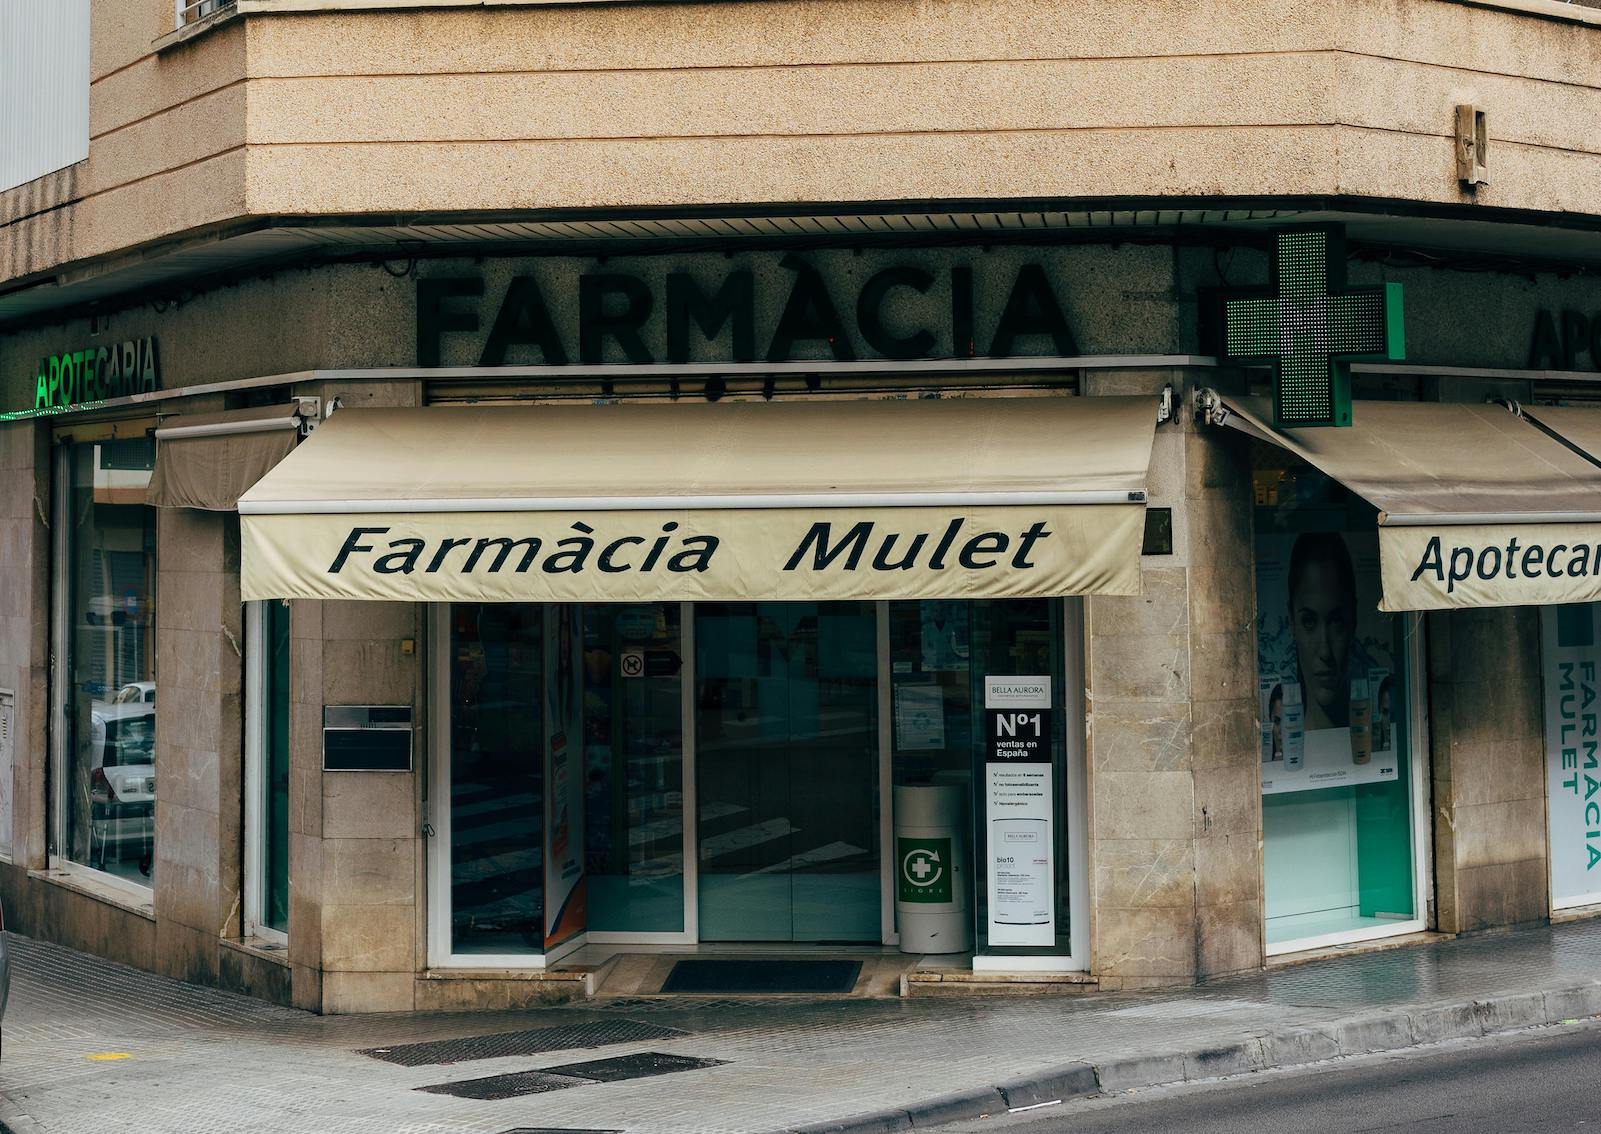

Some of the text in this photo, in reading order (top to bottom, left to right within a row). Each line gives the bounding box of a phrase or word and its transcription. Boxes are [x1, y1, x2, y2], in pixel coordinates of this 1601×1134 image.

[416, 253, 1079, 366] FARMÀCIA
[36, 335, 159, 410] APOTECARIA
[328, 521, 1053, 575] Farmàcia Mulet
[996, 713, 1041, 737] Nº1
[996, 749, 1028, 758] España
[1558, 662, 1579, 796] MULET
